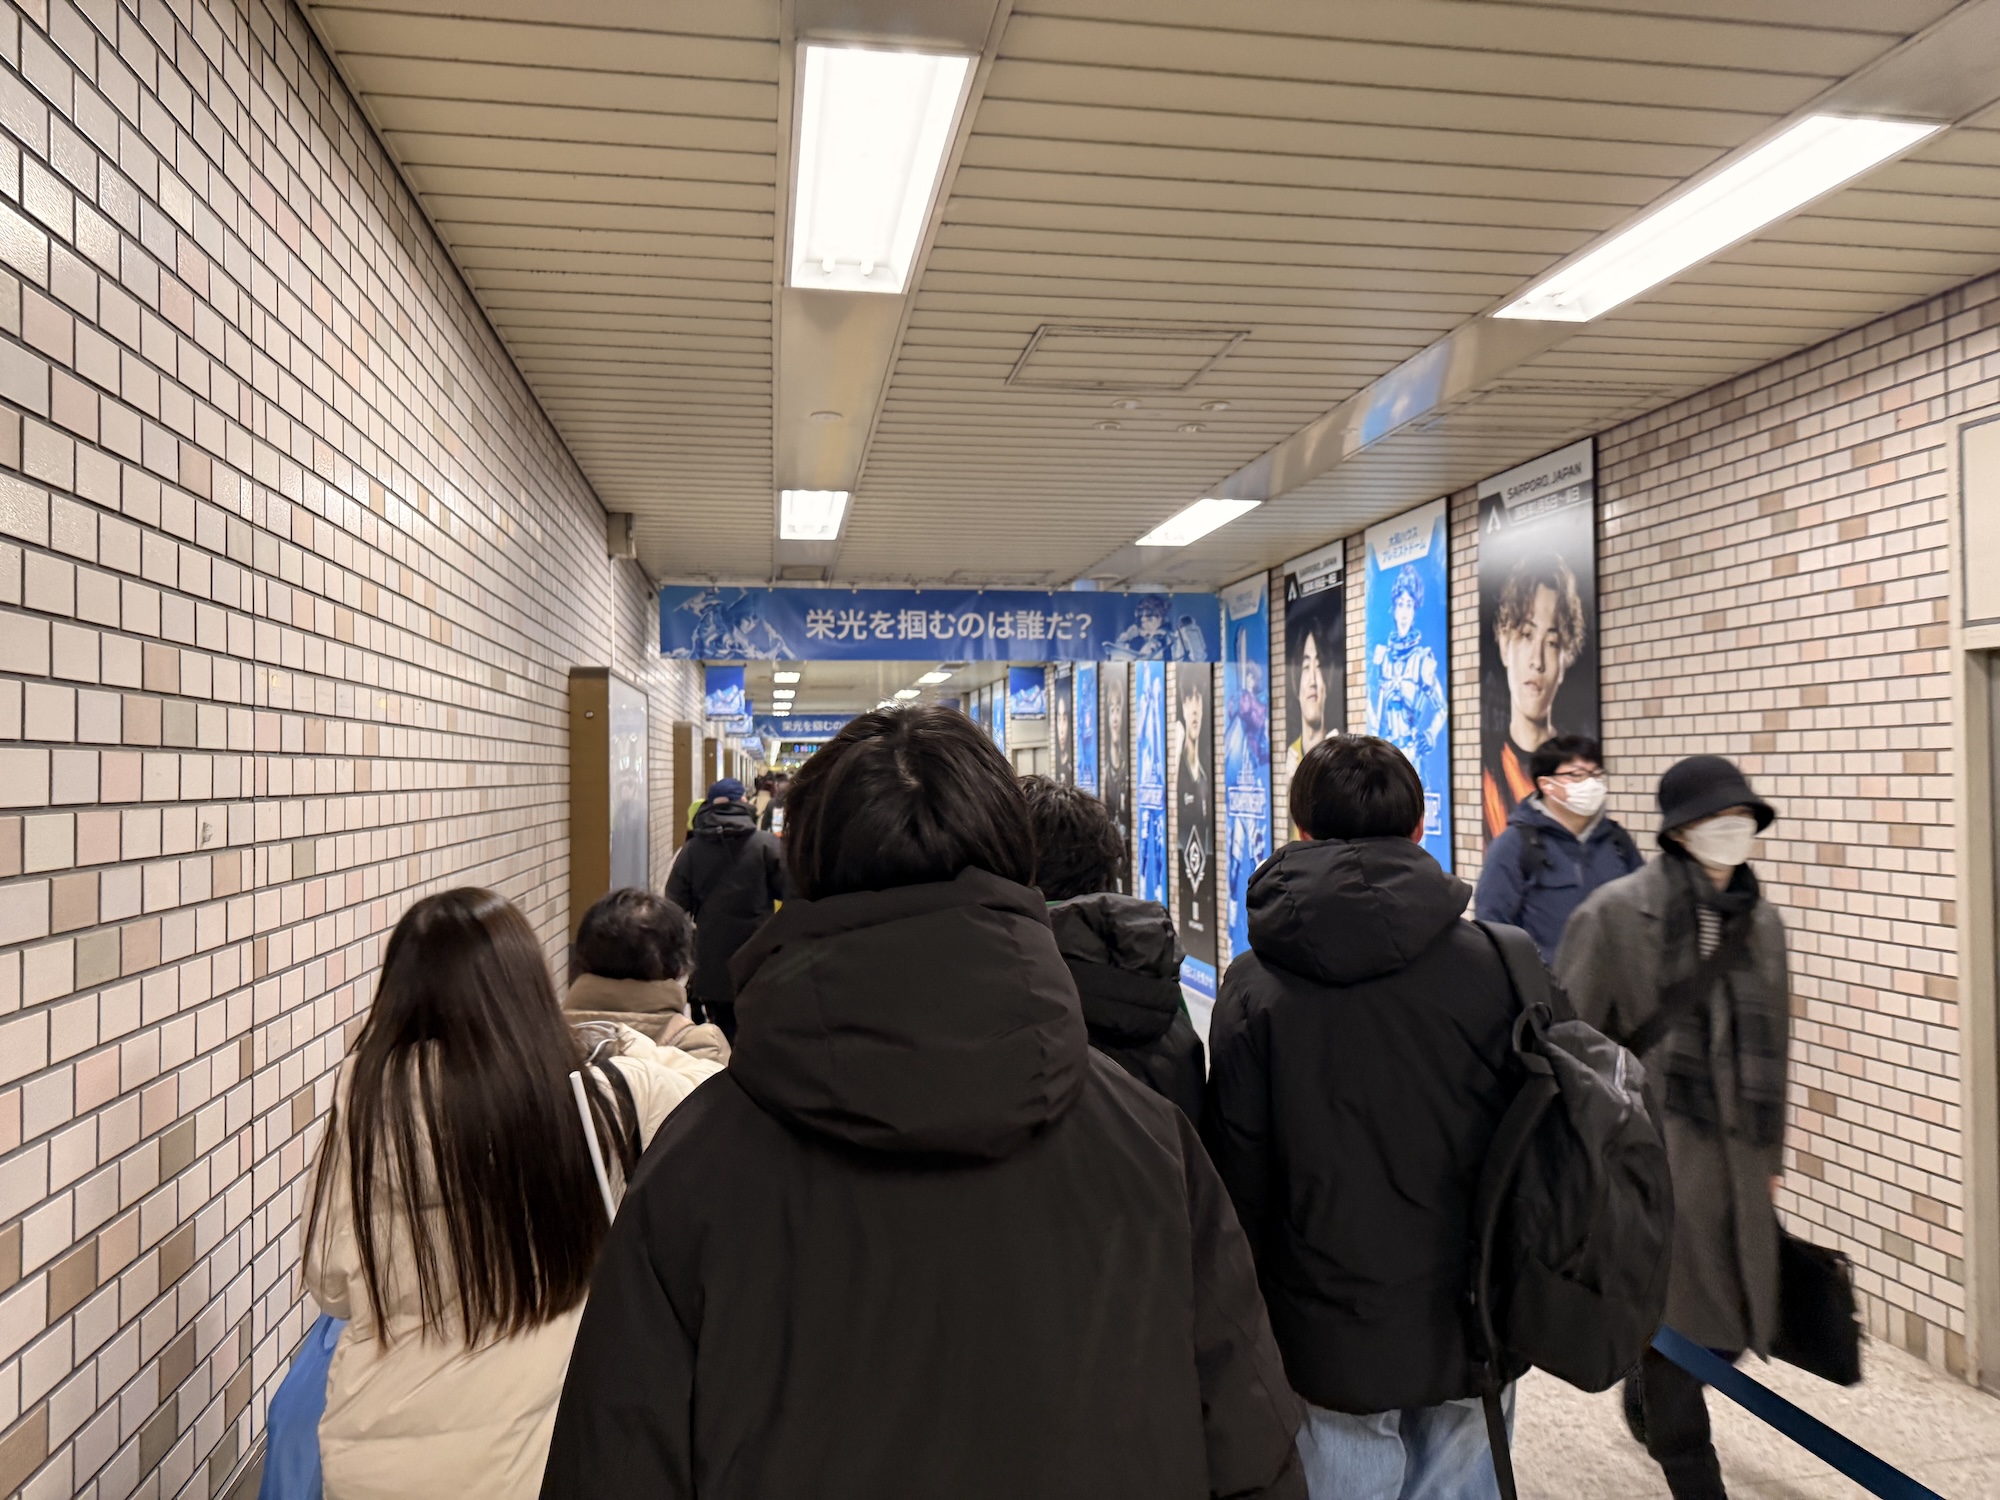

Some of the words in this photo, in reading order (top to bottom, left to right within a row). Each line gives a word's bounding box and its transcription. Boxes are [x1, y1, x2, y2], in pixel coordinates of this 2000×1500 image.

[1507, 474, 1550, 500] SAPPORO
[1551, 461, 1582, 484] JAPAN
[805, 609, 1093, 640] 栄光を掴むのは誰だ?
